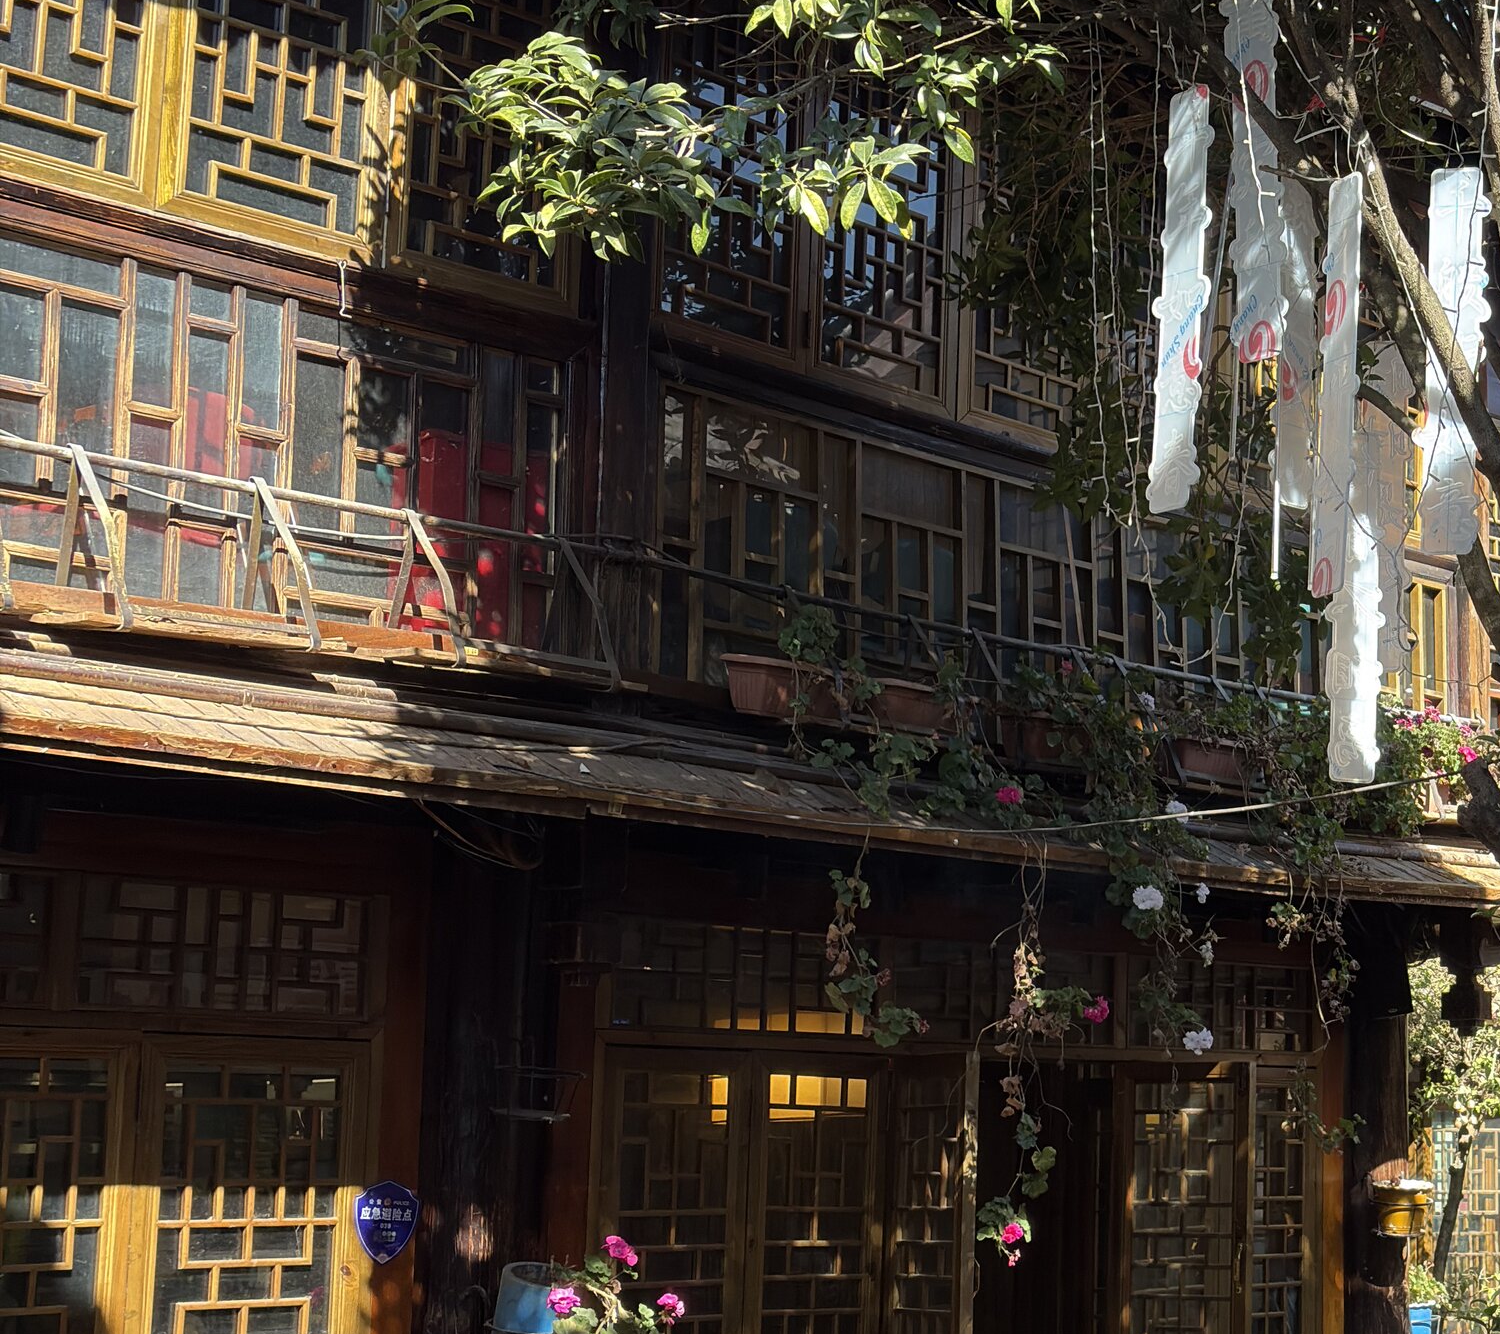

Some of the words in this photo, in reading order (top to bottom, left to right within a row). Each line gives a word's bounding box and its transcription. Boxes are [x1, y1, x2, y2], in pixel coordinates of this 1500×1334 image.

[361, 1207, 412, 1221] 应急避险点
